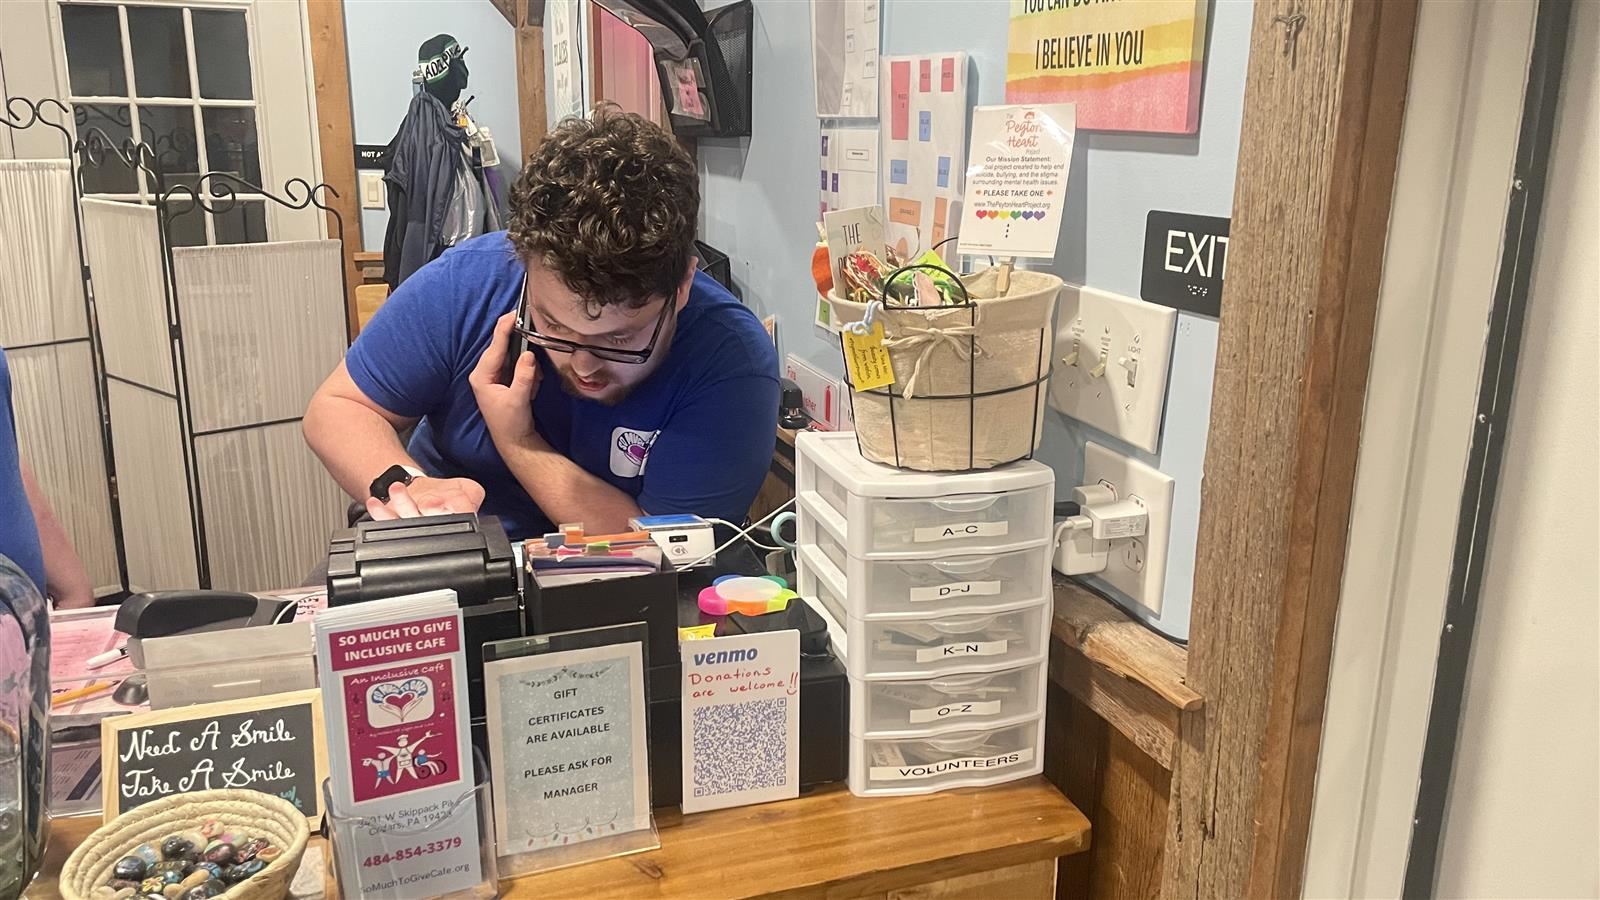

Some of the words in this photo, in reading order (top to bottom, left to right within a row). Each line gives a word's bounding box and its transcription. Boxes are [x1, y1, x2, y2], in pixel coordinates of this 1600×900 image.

[1035, 39, 1040, 70] I
[1042, 34, 1093, 69] BELIEVE
[1096, 32, 1111, 66] IN
[1116, 29, 1145, 66] YOU
[1006, 120, 1042, 137] Peyton
[1007, 136, 1039, 148] Heart
[842, 223, 862, 246] THE
[1164, 229, 1230, 280] EXIT
[338, 635, 357, 647] SO
[360, 628, 400, 643] MUCH
[402, 626, 420, 637] TO
[423, 621, 452, 633] GIVE
[344, 642, 413, 662] INCLUSIVE
[415, 637, 446, 650] CAFE
[694, 648, 758, 666] venmo
[350, 678, 369, 686] An
[371, 668, 419, 682] Inclusive
[688, 667, 772, 685] Donations
[554, 688, 578, 699] GIFT
[692, 689, 715, 698] are
[729, 681, 785, 693] welcome
[528, 706, 605, 726] CERTIFICATES
[119, 730, 181, 762] Need
[190, 721, 221, 751] A
[231, 718, 296, 749] Smile
[526, 733, 548, 745] ARE
[550, 722, 611, 741] AVAILABLE
[524, 764, 566, 779] PLEASE
[568, 759, 588, 772] ASK
[591, 755, 613, 767] FOR
[899, 753, 1019, 776] VOLUNTEERS
[121, 768, 174, 798] Take
[178, 758, 215, 791] A
[222, 757, 296, 789] Smile
[543, 782, 599, 800] MANAGER
[385, 812, 396, 821] W
[398, 804, 439, 818] Skippack
[441, 799, 459, 809] Pi
[407, 818, 421, 827] PA
[363, 836, 462, 868] 484-854-3379
